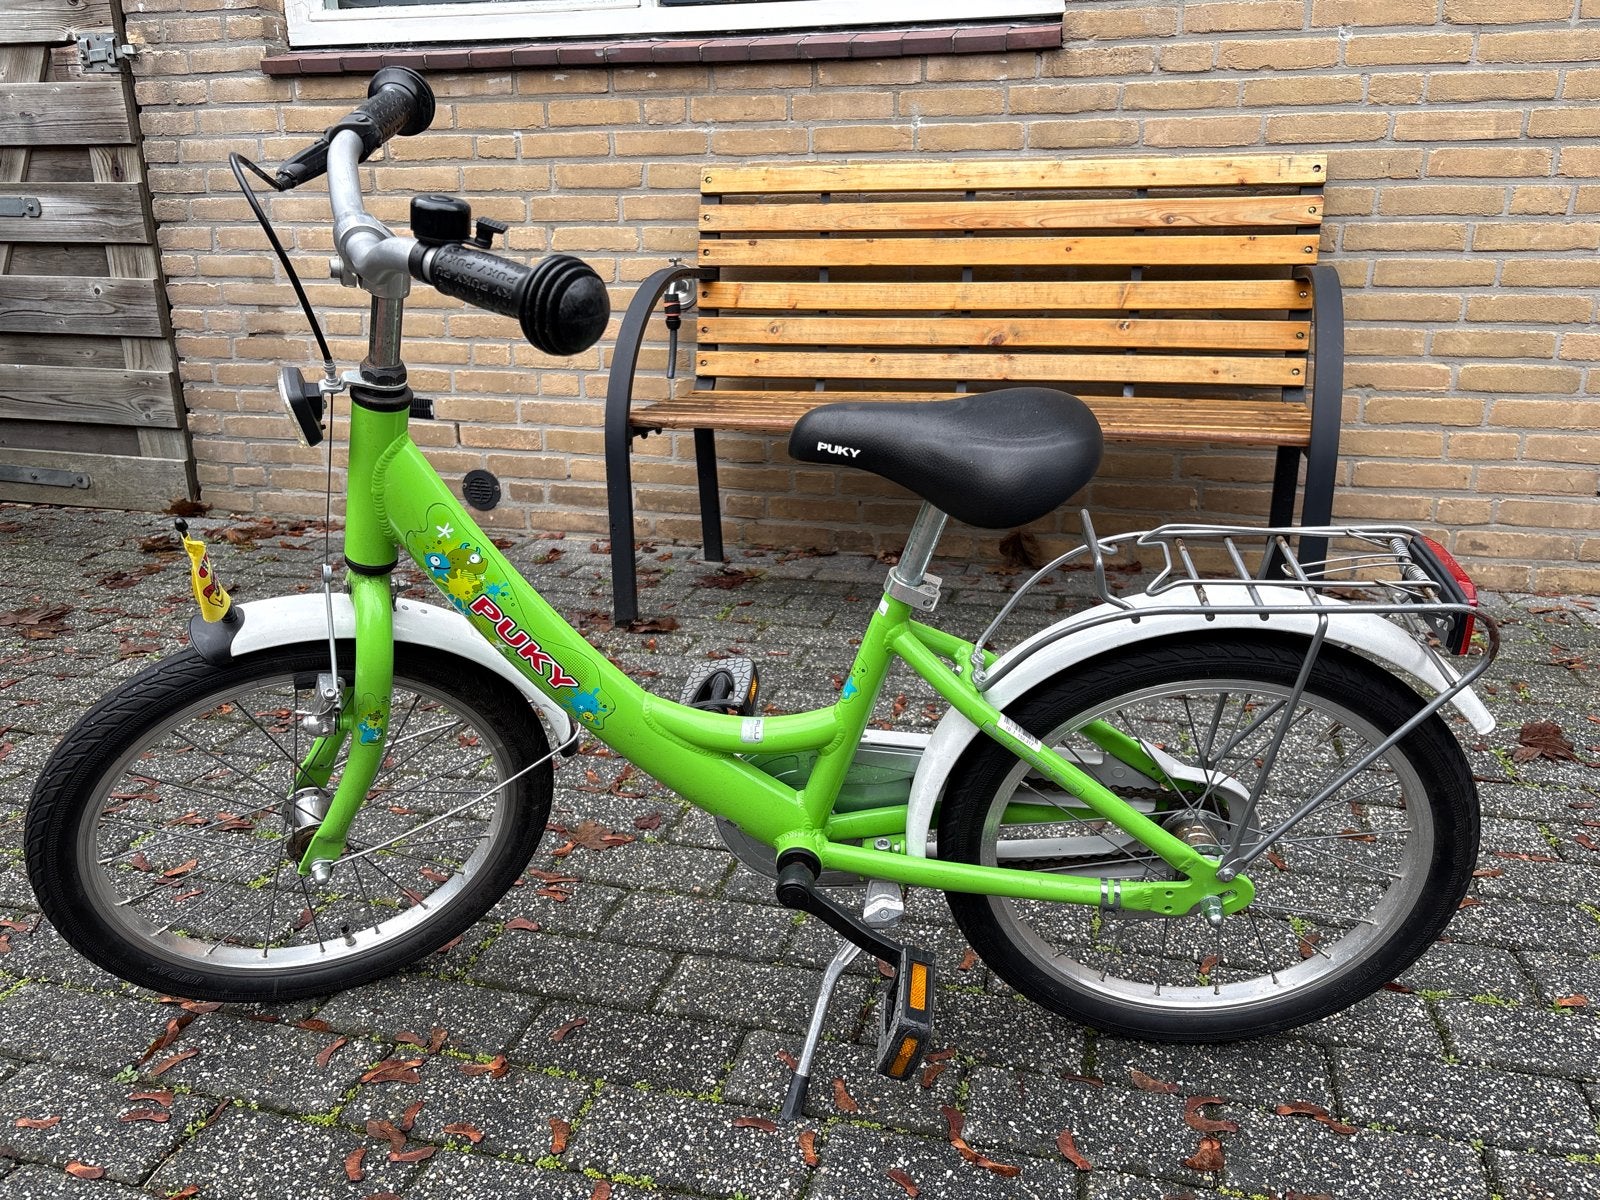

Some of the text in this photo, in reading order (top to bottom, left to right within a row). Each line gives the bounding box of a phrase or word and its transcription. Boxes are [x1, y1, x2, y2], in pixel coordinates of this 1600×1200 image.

[454, 271, 489, 292] PUKY
[817, 441, 861, 458] PUKY
[469, 594, 579, 689] PUKY
